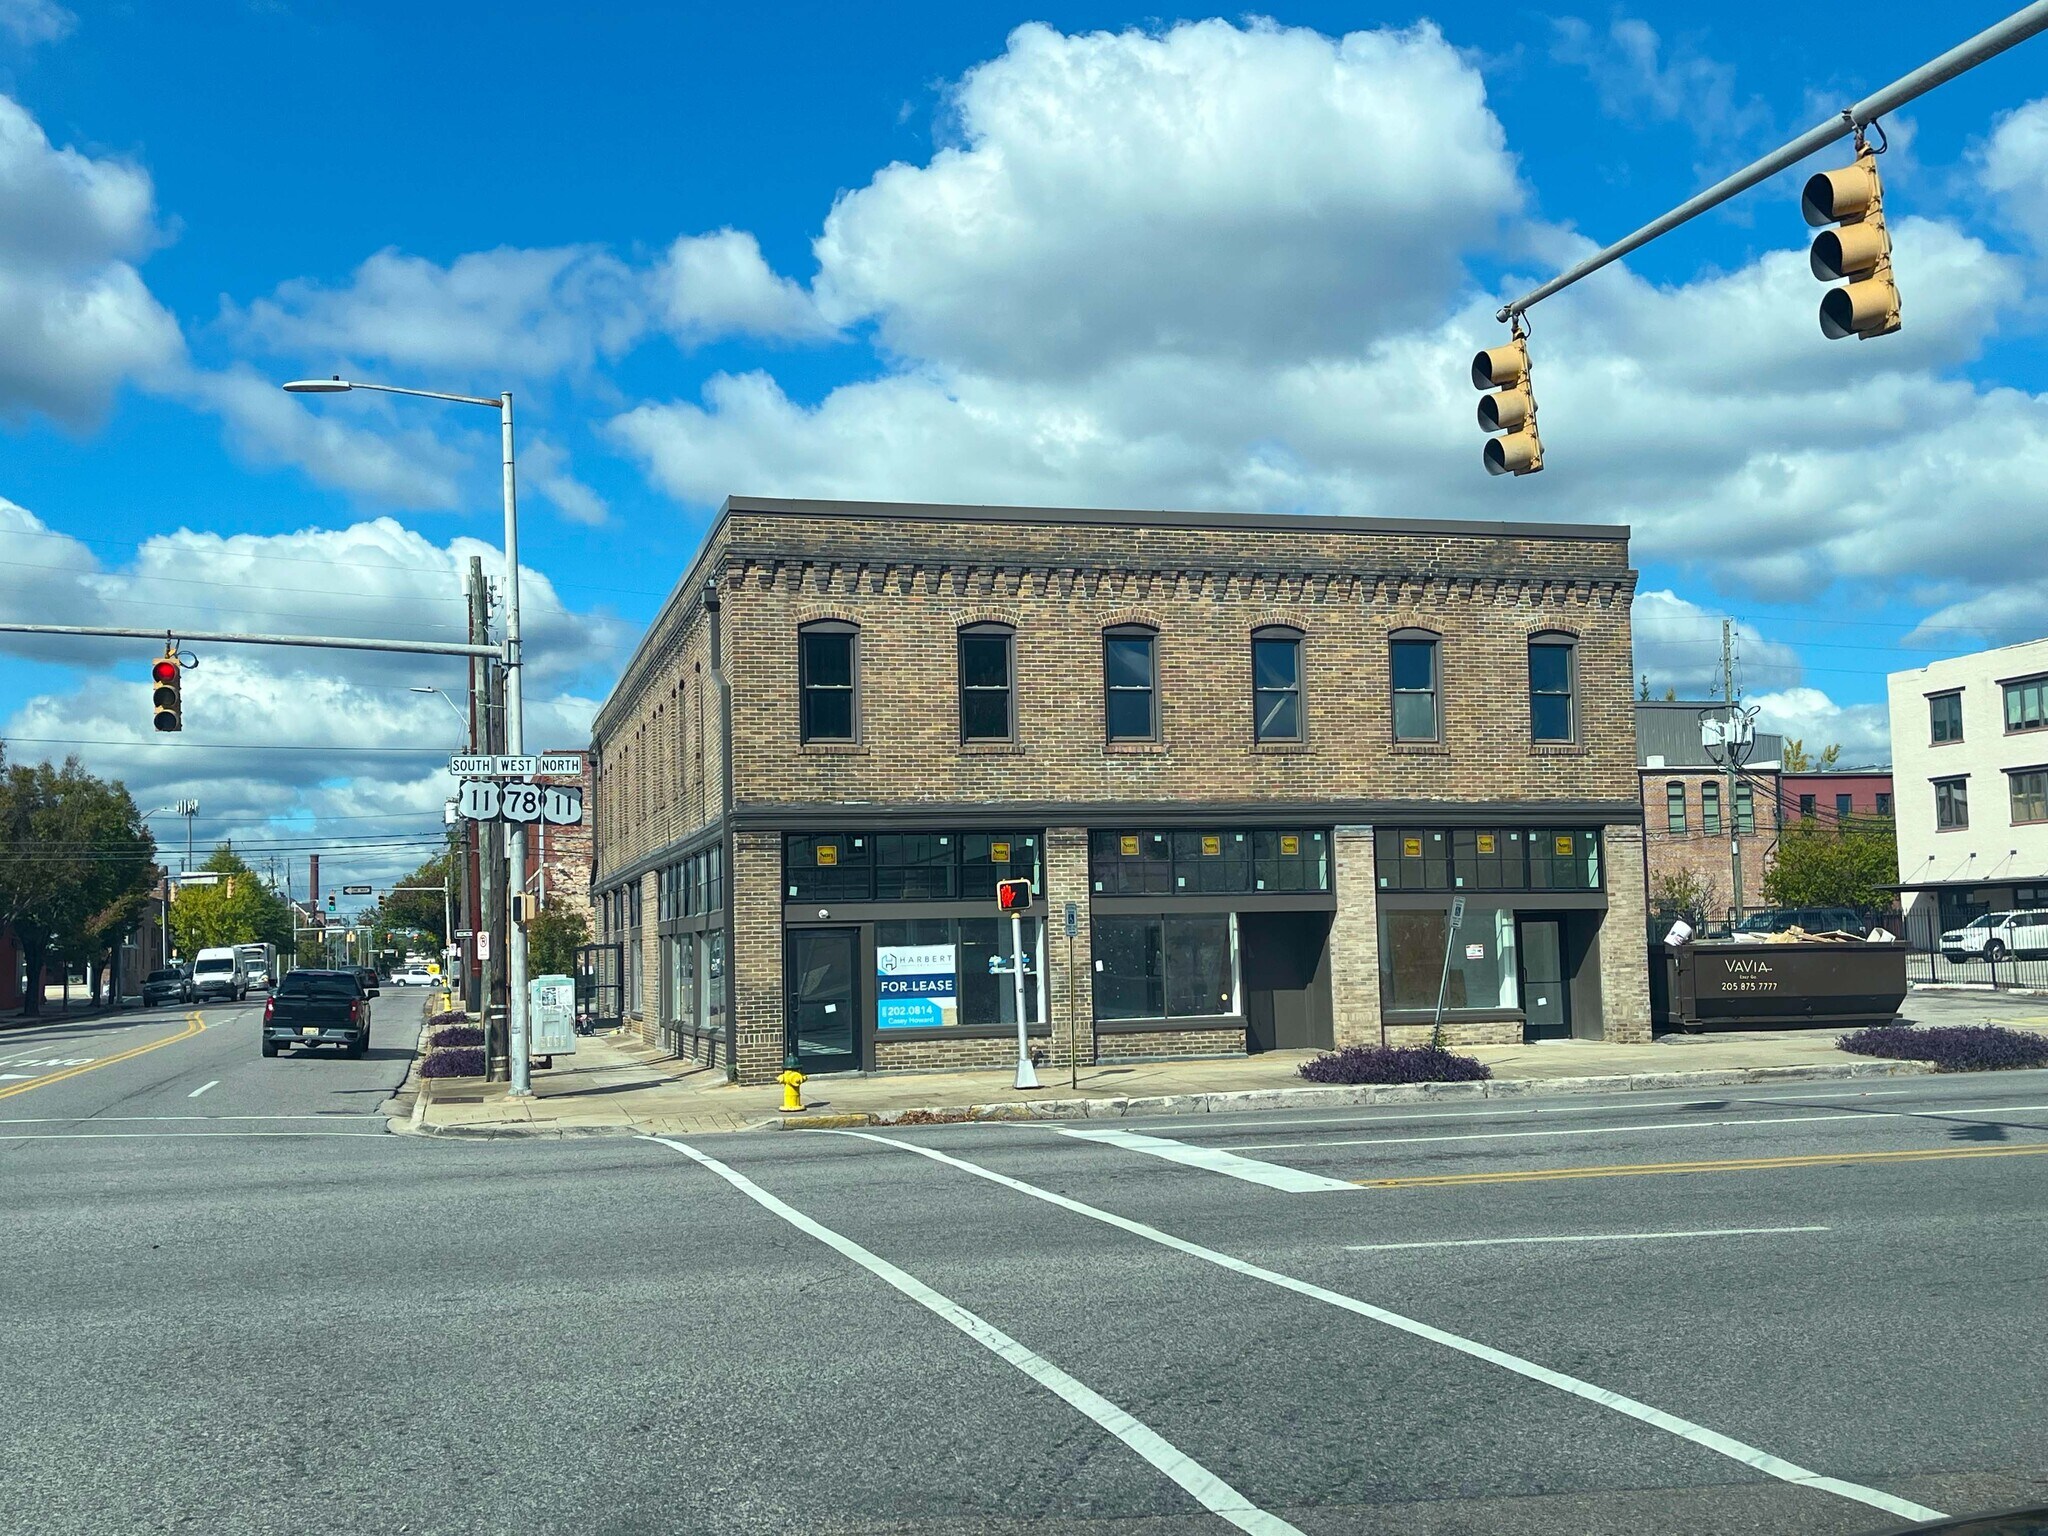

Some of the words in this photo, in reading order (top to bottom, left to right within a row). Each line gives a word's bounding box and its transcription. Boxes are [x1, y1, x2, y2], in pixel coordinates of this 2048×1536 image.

[453, 760, 490, 772] SOUTH
[501, 760, 532, 771] WEST
[542, 760, 579, 771] NORTH
[472, 789, 489, 811] 11
[507, 791, 536, 814] 78
[555, 794, 571, 815] 11
[899, 955, 952, 963] HARBERT
[881, 981, 907, 992] FOR
[912, 980, 953, 992] LEASE
[1721, 982, 1738, 991] 205
[1740, 982, 1756, 991] 875
[1758, 982, 1778, 991] 7777
[888, 1005, 933, 1016] 202.0814
